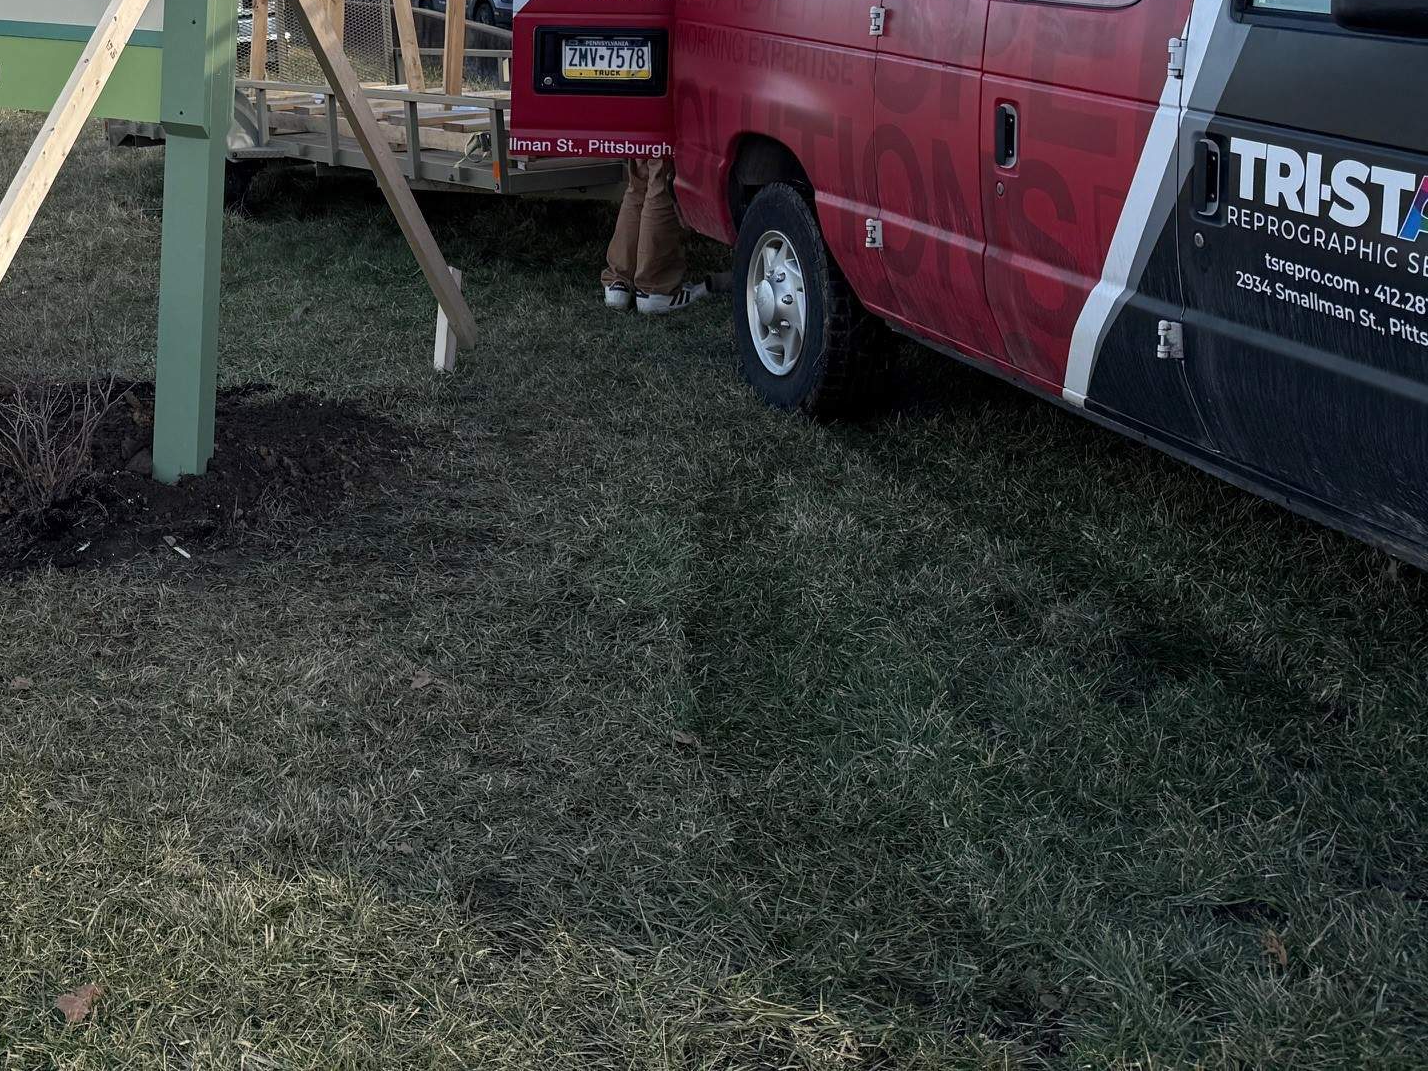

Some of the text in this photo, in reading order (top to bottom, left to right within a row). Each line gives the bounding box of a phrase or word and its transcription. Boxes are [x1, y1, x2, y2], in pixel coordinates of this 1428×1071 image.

[594, 69, 621, 77] TRUCK
[1227, 206, 1399, 269] REPROGRAPHIC
[1265, 253, 1360, 297] tsrepro.com
[1234, 270, 1273, 297] 2934
[1274, 282, 1356, 324] Smallman
[1358, 309, 1386, 337] St.,
